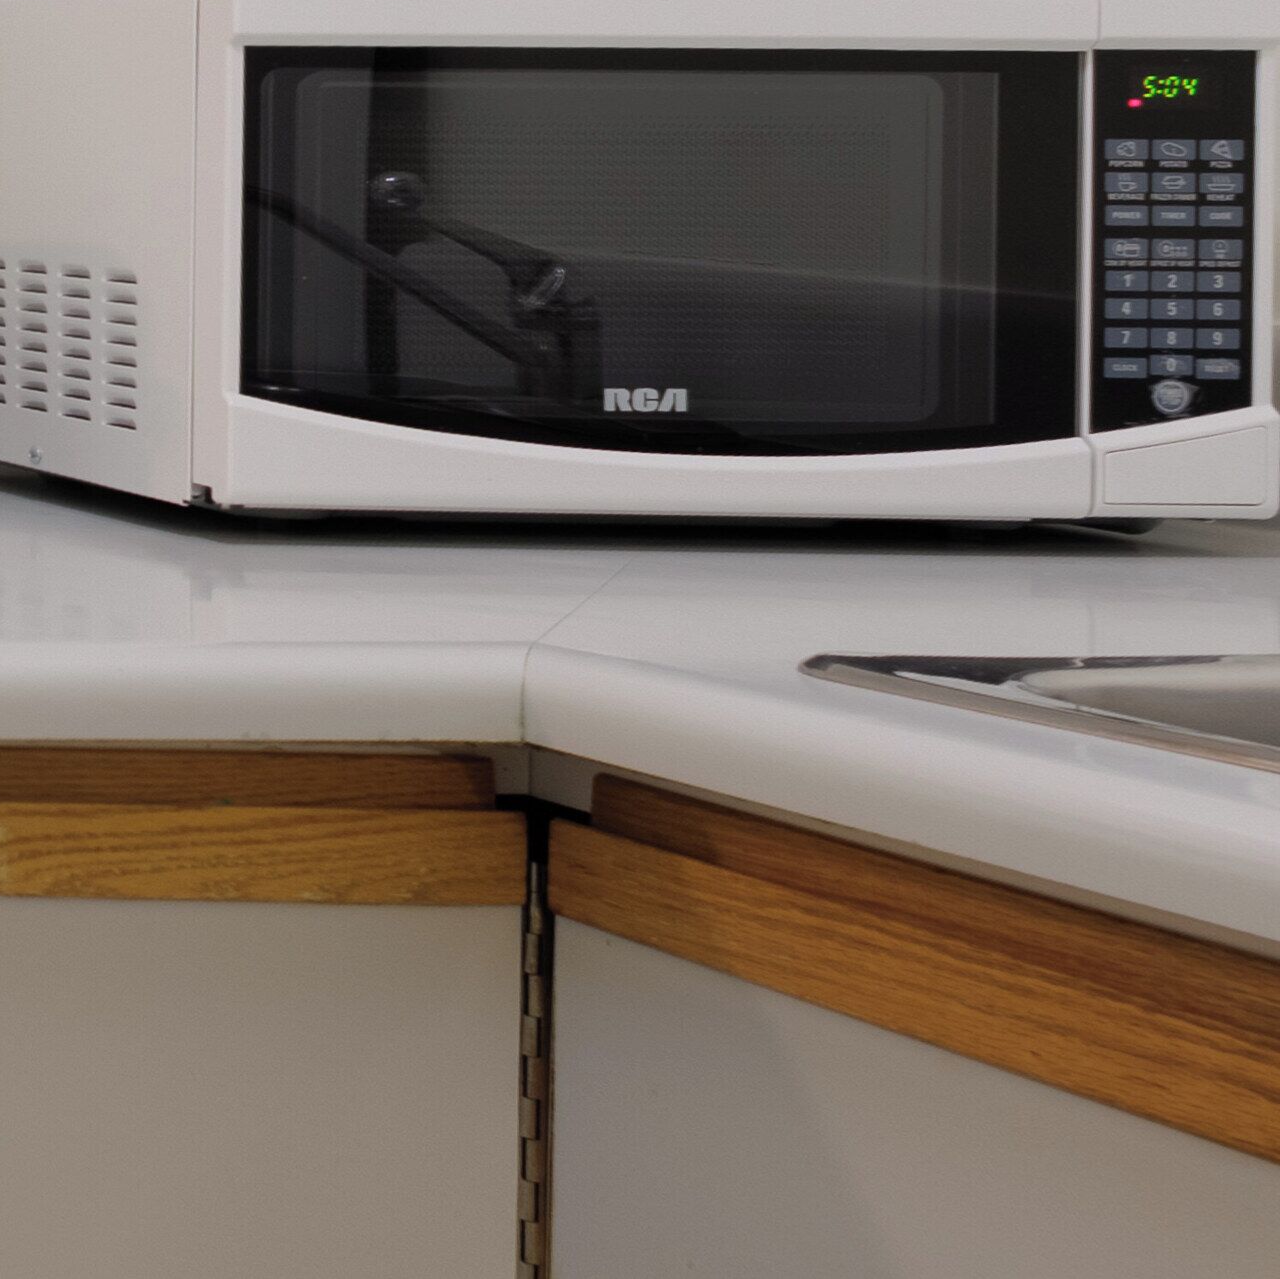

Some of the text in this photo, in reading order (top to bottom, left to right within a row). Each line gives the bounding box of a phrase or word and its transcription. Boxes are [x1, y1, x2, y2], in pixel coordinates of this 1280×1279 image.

[1143, 75, 1198, 97] 5:04
[1123, 274, 1133, 287] 1
[1167, 274, 1178, 288] 2
[1213, 274, 1224, 289] 3
[1121, 301, 1132, 315] 4
[1167, 302, 1177, 316] 5
[1213, 302, 1223, 316] 6
[1121, 330, 1131, 344] 7
[1166, 331, 1177, 345] 8
[1212, 331, 1223, 346] 9
[1166, 357, 1177, 372] 0
[603, 387, 688, 412] RCA
